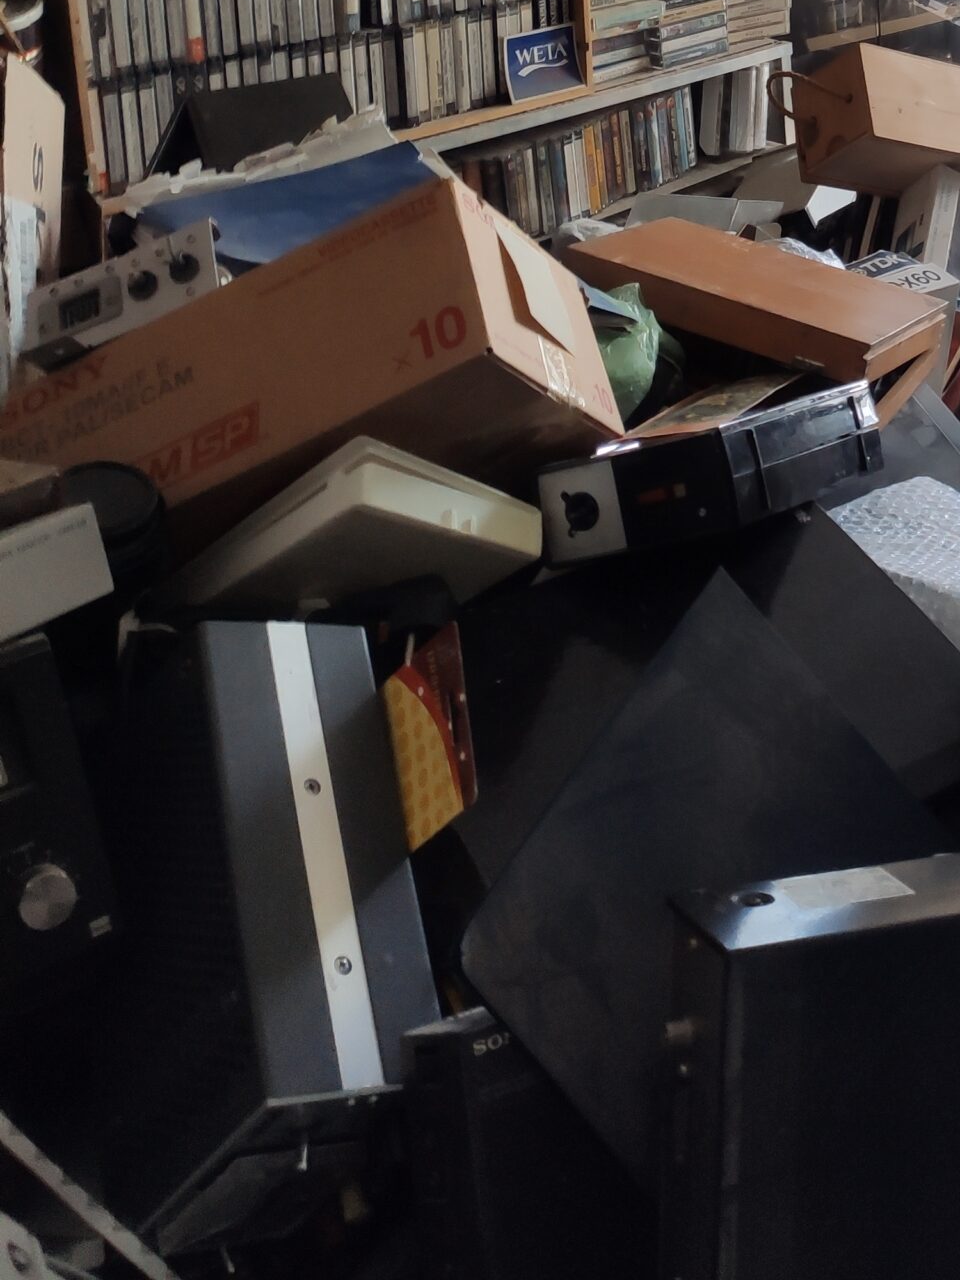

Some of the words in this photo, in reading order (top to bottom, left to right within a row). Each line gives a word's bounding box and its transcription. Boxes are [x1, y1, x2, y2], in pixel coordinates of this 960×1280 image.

[514, 42, 568, 66] WETA
[860, 254, 909, 272] TDK
[472, 1032, 510, 1057] SO
